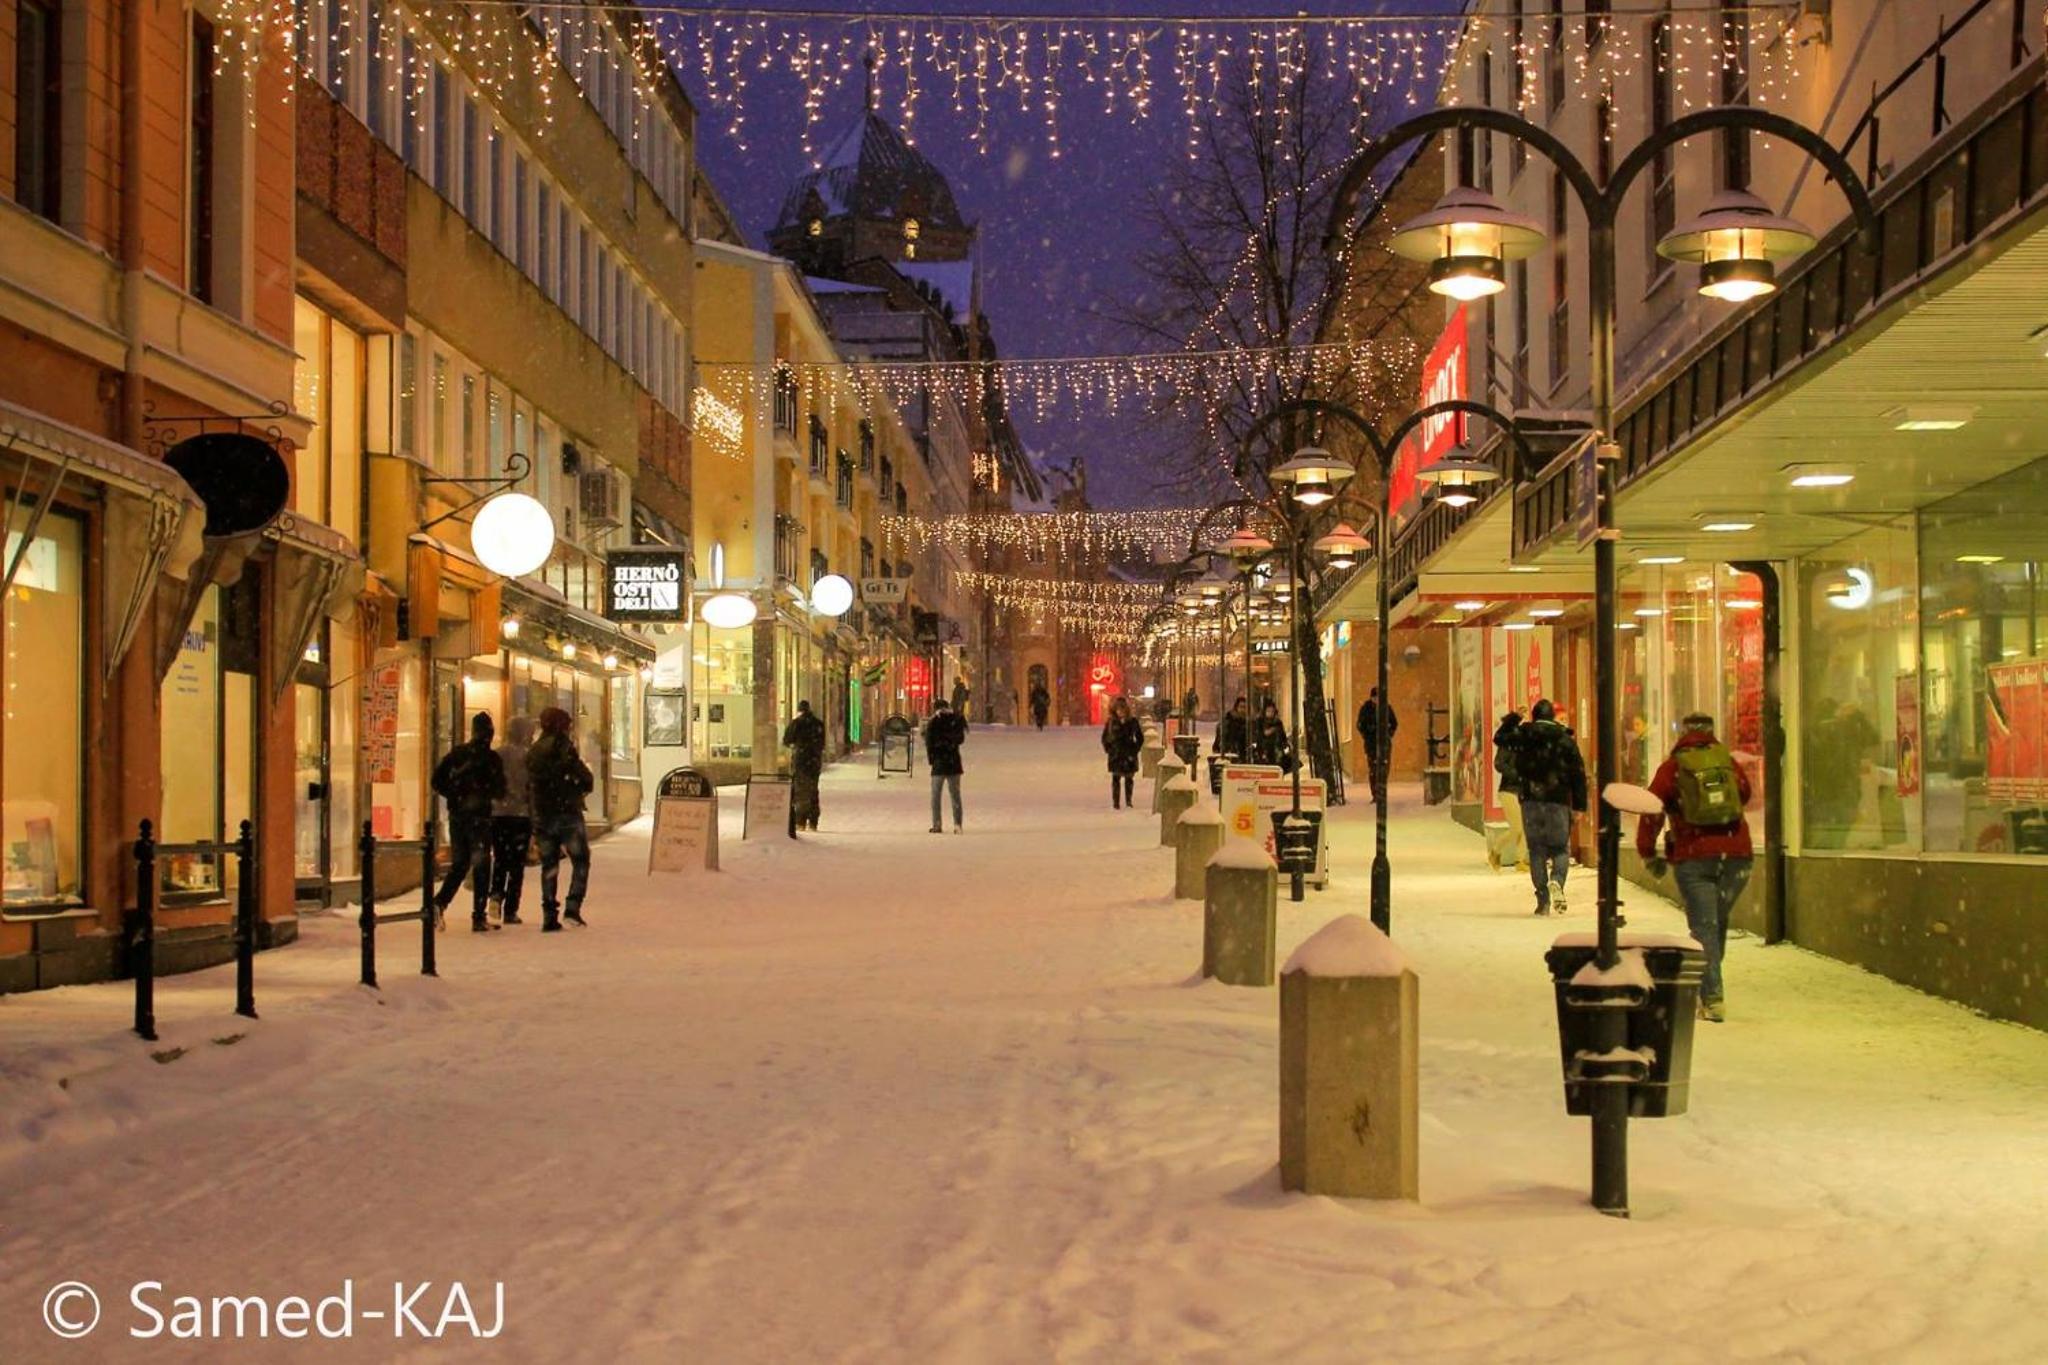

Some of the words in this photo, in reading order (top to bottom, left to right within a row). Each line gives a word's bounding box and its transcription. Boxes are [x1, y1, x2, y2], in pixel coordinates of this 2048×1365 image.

[615, 563, 679, 581] HERNÖ
[613, 582, 650, 597] OST
[614, 597, 650, 610] DELI
[1236, 813, 1251, 831] 5
